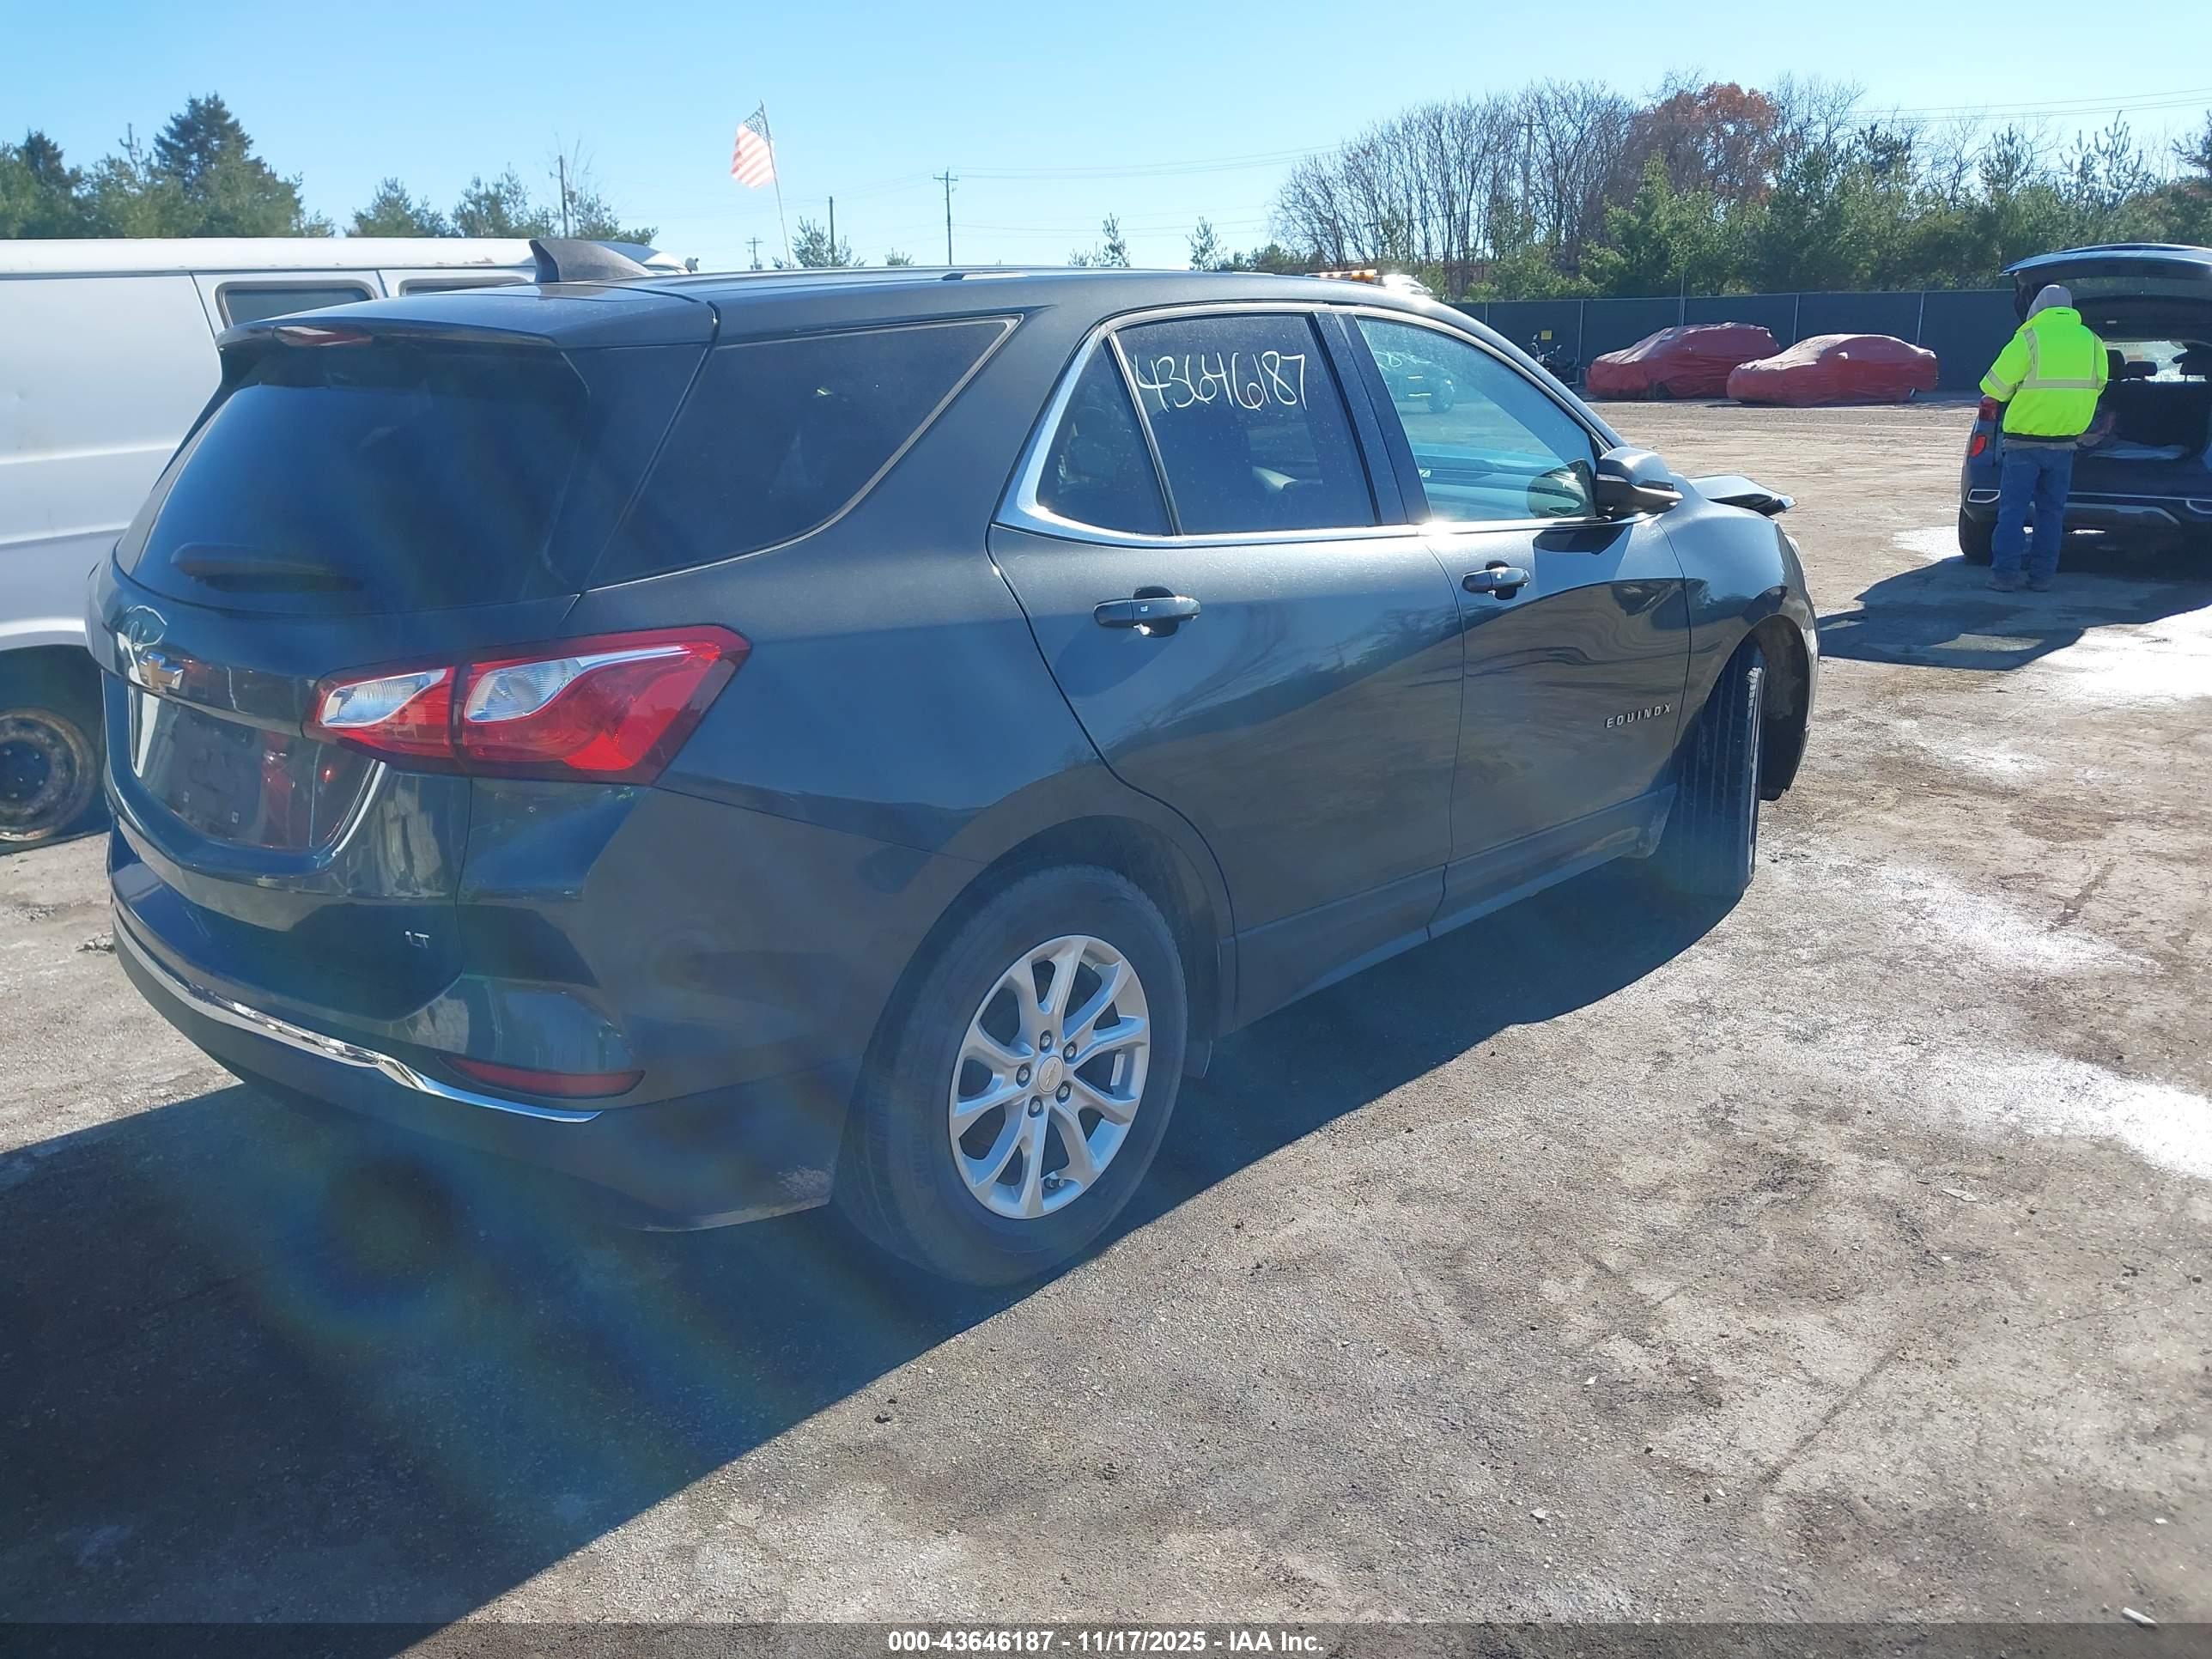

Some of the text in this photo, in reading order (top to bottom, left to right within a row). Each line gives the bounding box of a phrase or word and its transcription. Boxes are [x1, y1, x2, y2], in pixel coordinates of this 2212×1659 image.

[1133, 350, 1308, 413] 43646187
[1606, 702, 1672, 729] EQUINOX
[404, 930, 429, 949] LT
